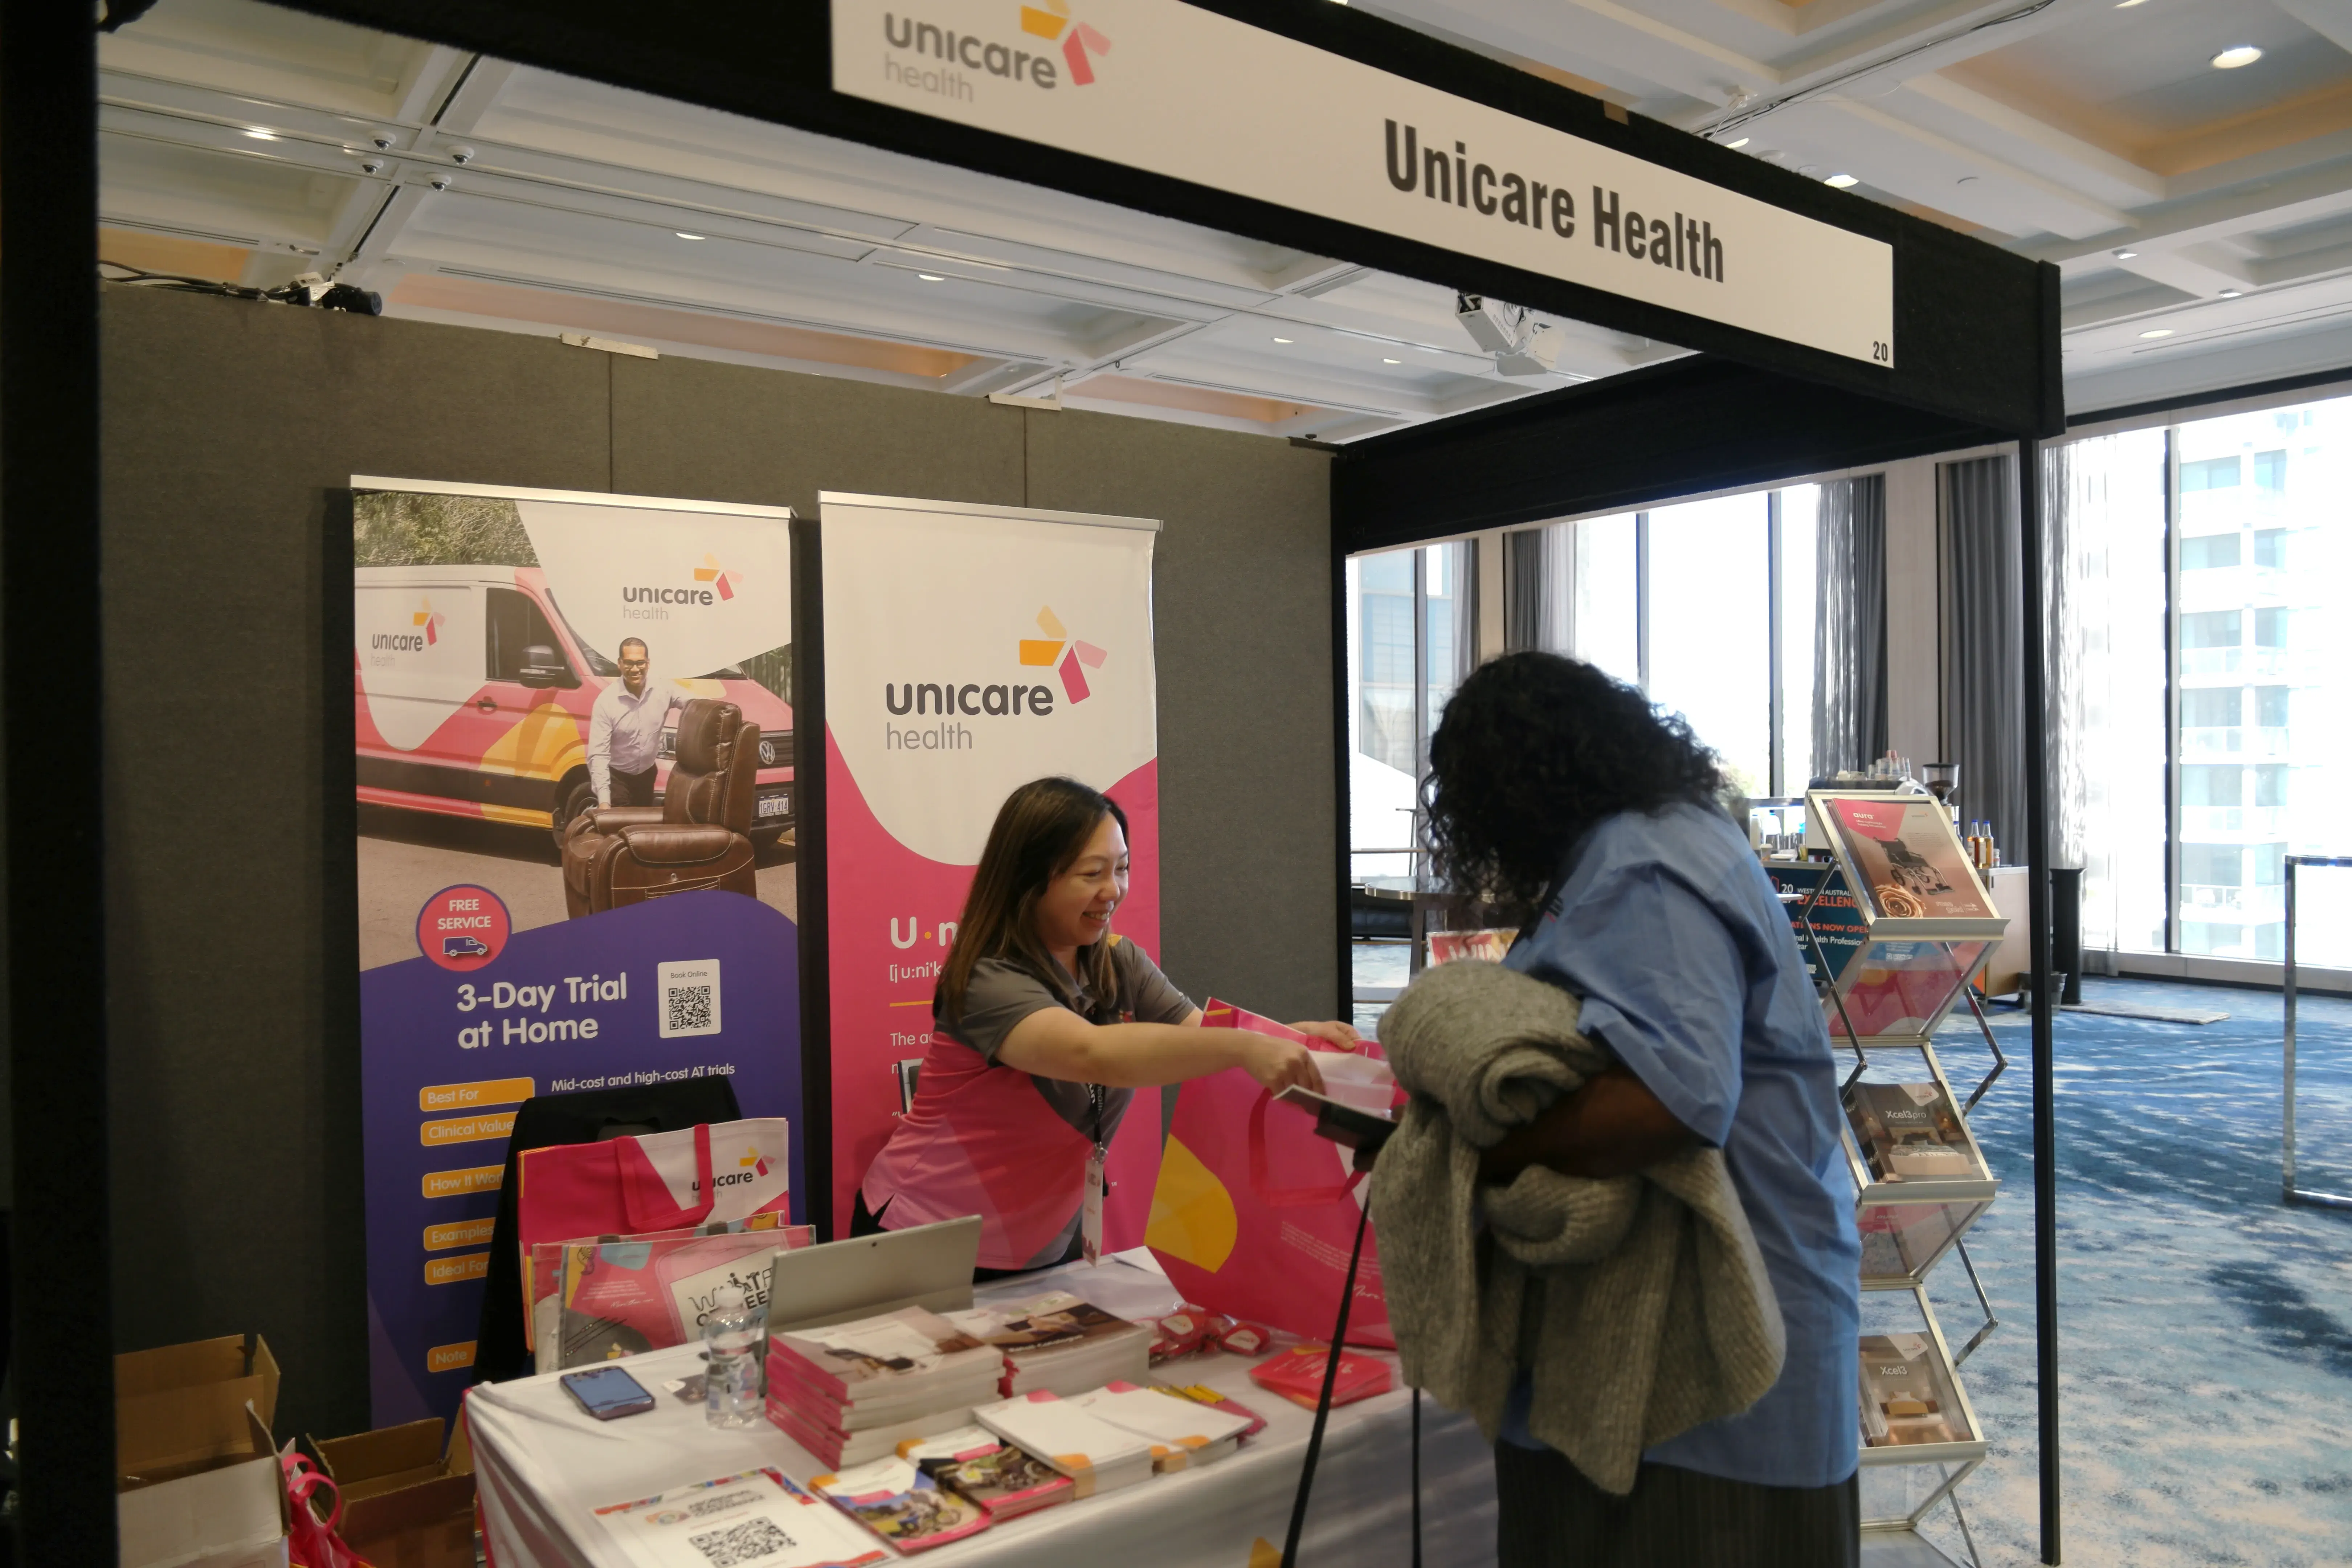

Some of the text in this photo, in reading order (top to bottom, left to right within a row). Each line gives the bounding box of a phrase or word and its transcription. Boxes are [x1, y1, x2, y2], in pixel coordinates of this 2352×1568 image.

[884, 12, 1057, 89] unicare
[885, 52, 974, 103] health
[1384, 118, 1723, 283] Unicare Health
[1873, 340, 1888, 362] 20
[623, 587, 713, 605] unicare
[623, 605, 669, 620] health
[372, 634, 423, 652] unicare
[371, 653, 395, 667] health
[886, 683, 1054, 716] unicare
[887, 722, 972, 750] health
[1781, 883, 1793, 893] 20
[449, 899, 479, 911] FREE
[438, 916, 491, 930] SERVICE
[457, 972, 627, 1013] 3-Day Trial
[458, 1017, 599, 1049] at Home
[890, 1032, 915, 1046] The
[551, 1063, 735, 1092] Mid-cost and high-cost AT trials
[428, 1089, 479, 1104] Best For
[428, 1119, 515, 1139] Clinical Value
[431, 1179, 462, 1191] How
[465, 1175, 472, 1187] It
[692, 1172, 753, 1191] uicare
[432, 1225, 494, 1243] Examples
[433, 1260, 489, 1278] Ideal For
[436, 1350, 467, 1365] Note
[1880, 1365, 1908, 1375] Xcel3
